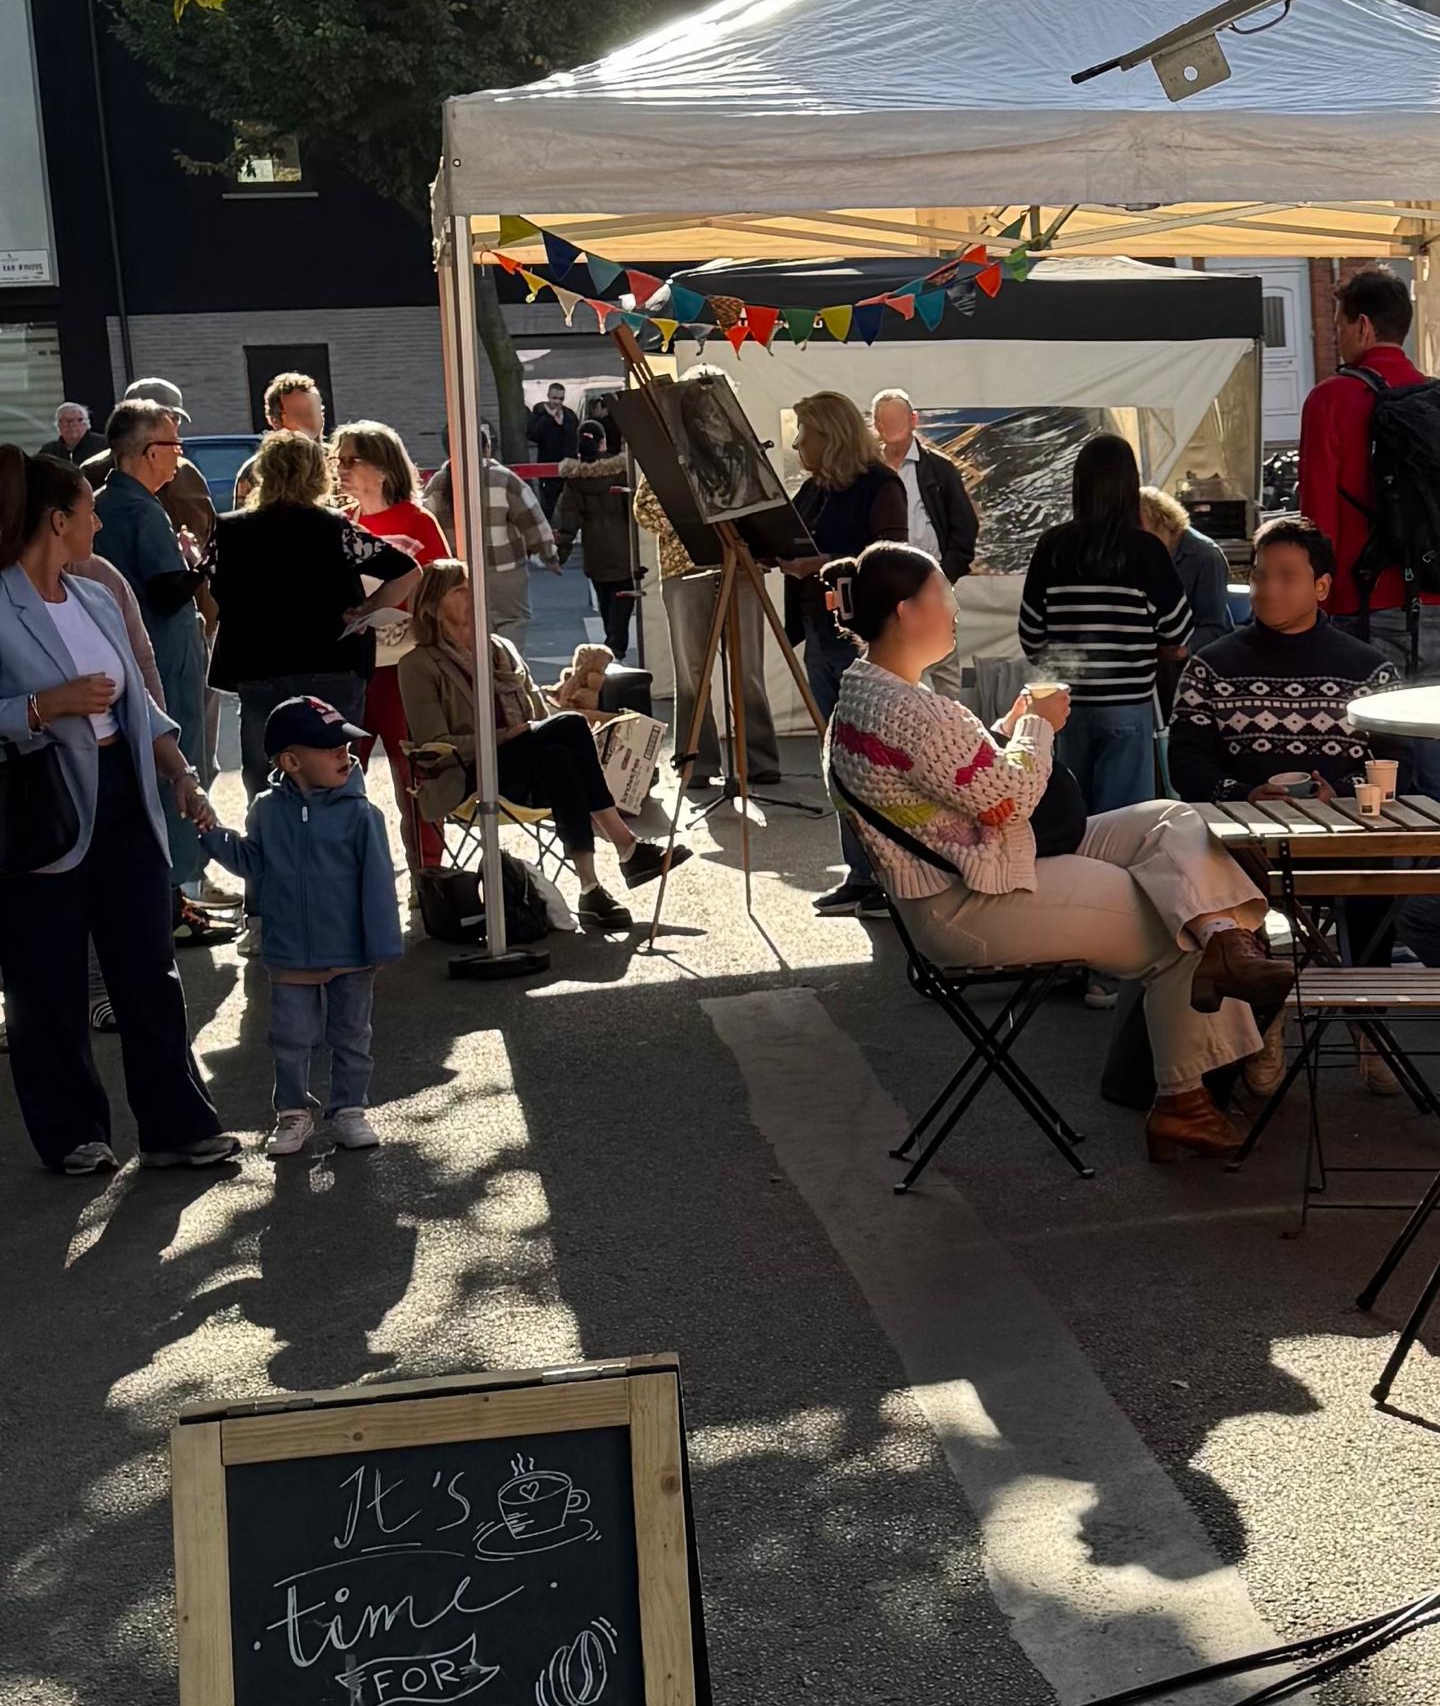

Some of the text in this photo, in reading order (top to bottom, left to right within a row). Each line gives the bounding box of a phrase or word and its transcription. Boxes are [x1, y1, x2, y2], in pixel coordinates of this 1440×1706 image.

[334, 1465, 470, 1550] It's
[266, 1575, 526, 1668] time
[372, 1659, 460, 1701] FOR
